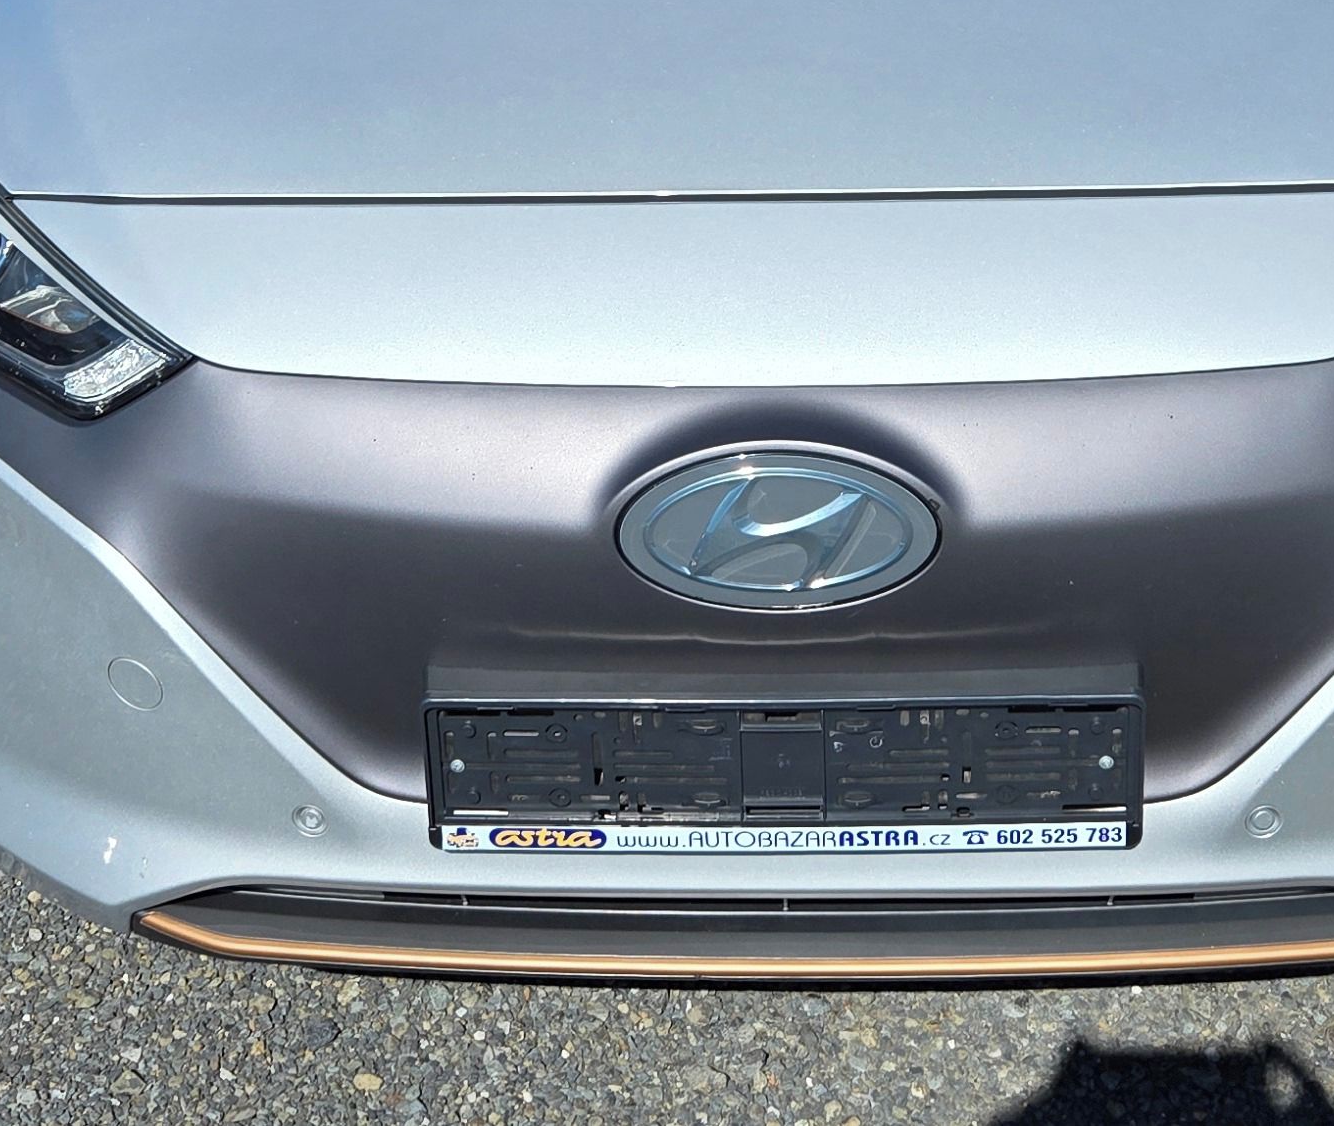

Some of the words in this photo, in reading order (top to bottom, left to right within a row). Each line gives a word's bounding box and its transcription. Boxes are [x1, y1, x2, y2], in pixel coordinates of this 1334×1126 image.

[494, 827, 602, 848] astra
[996, 829, 1034, 845] 602
[1041, 828, 1078, 844] 525
[1085, 827, 1123, 843] 783
